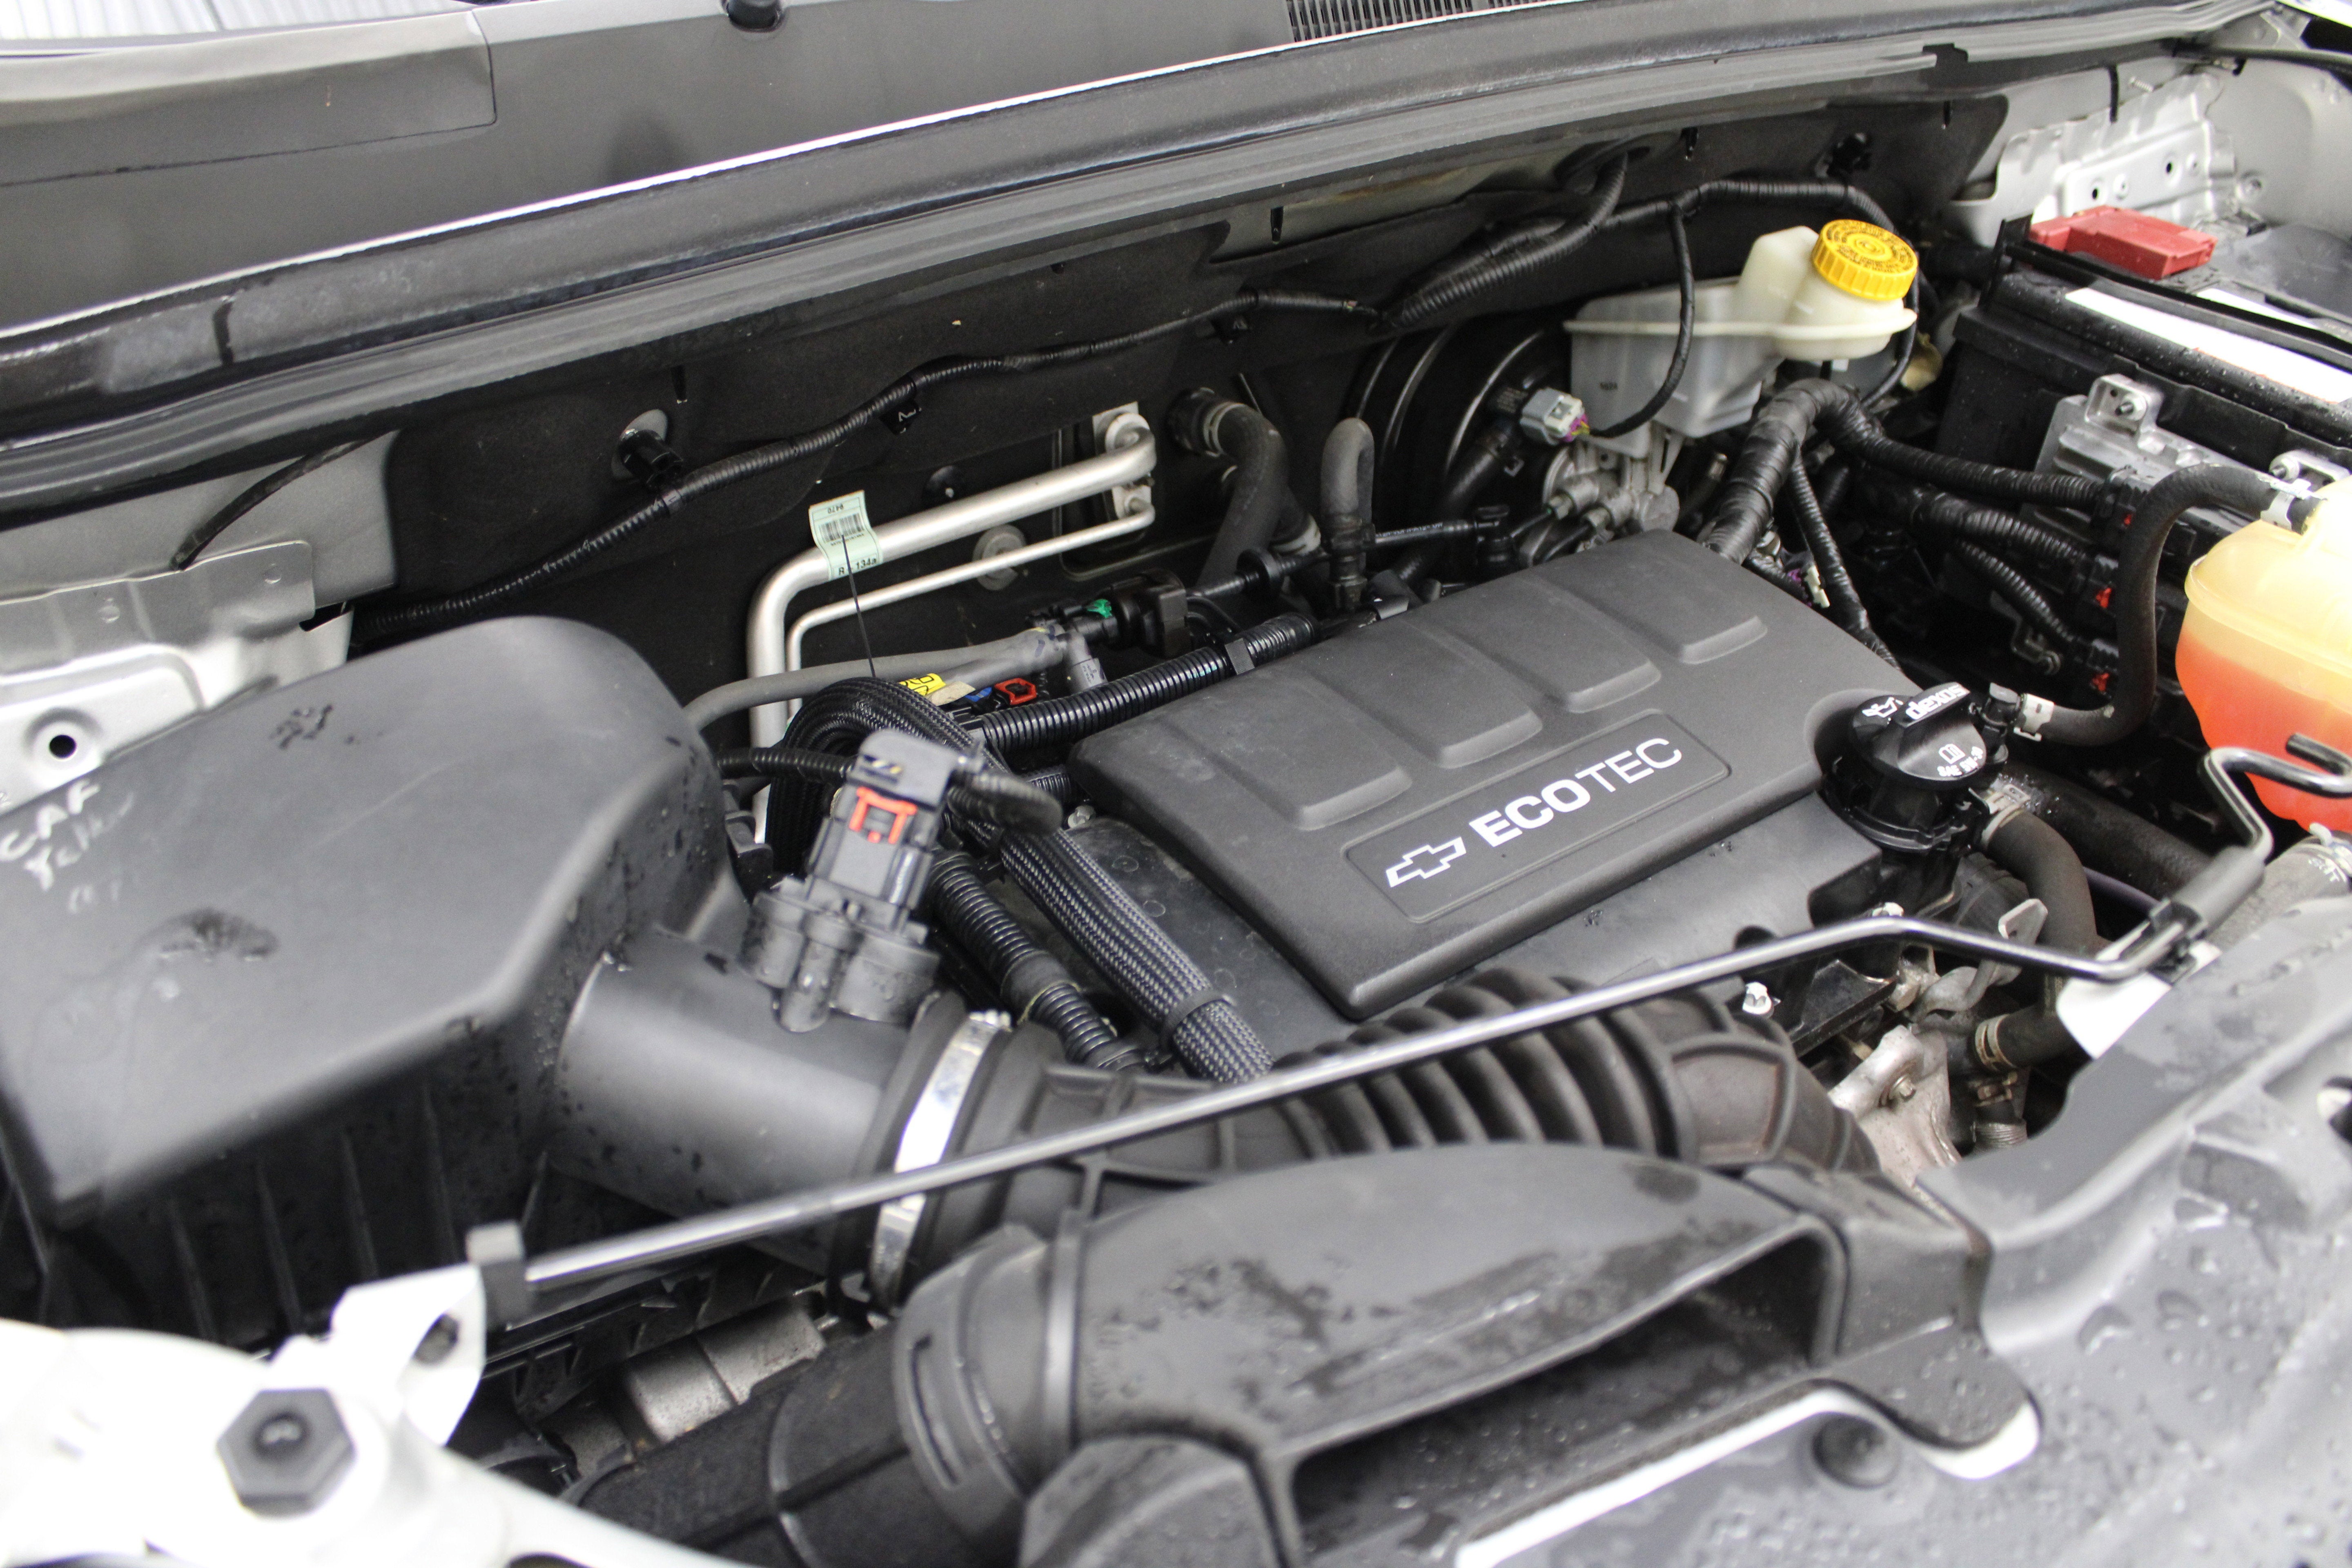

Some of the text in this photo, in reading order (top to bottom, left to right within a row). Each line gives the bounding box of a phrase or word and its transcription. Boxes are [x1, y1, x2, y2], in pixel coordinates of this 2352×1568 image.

[856, 558, 876, 569] 134a
[1905, 684, 1968, 720] dexos
[1937, 764, 1963, 777] SAE
[1469, 738, 1682, 848] ECOTEC
